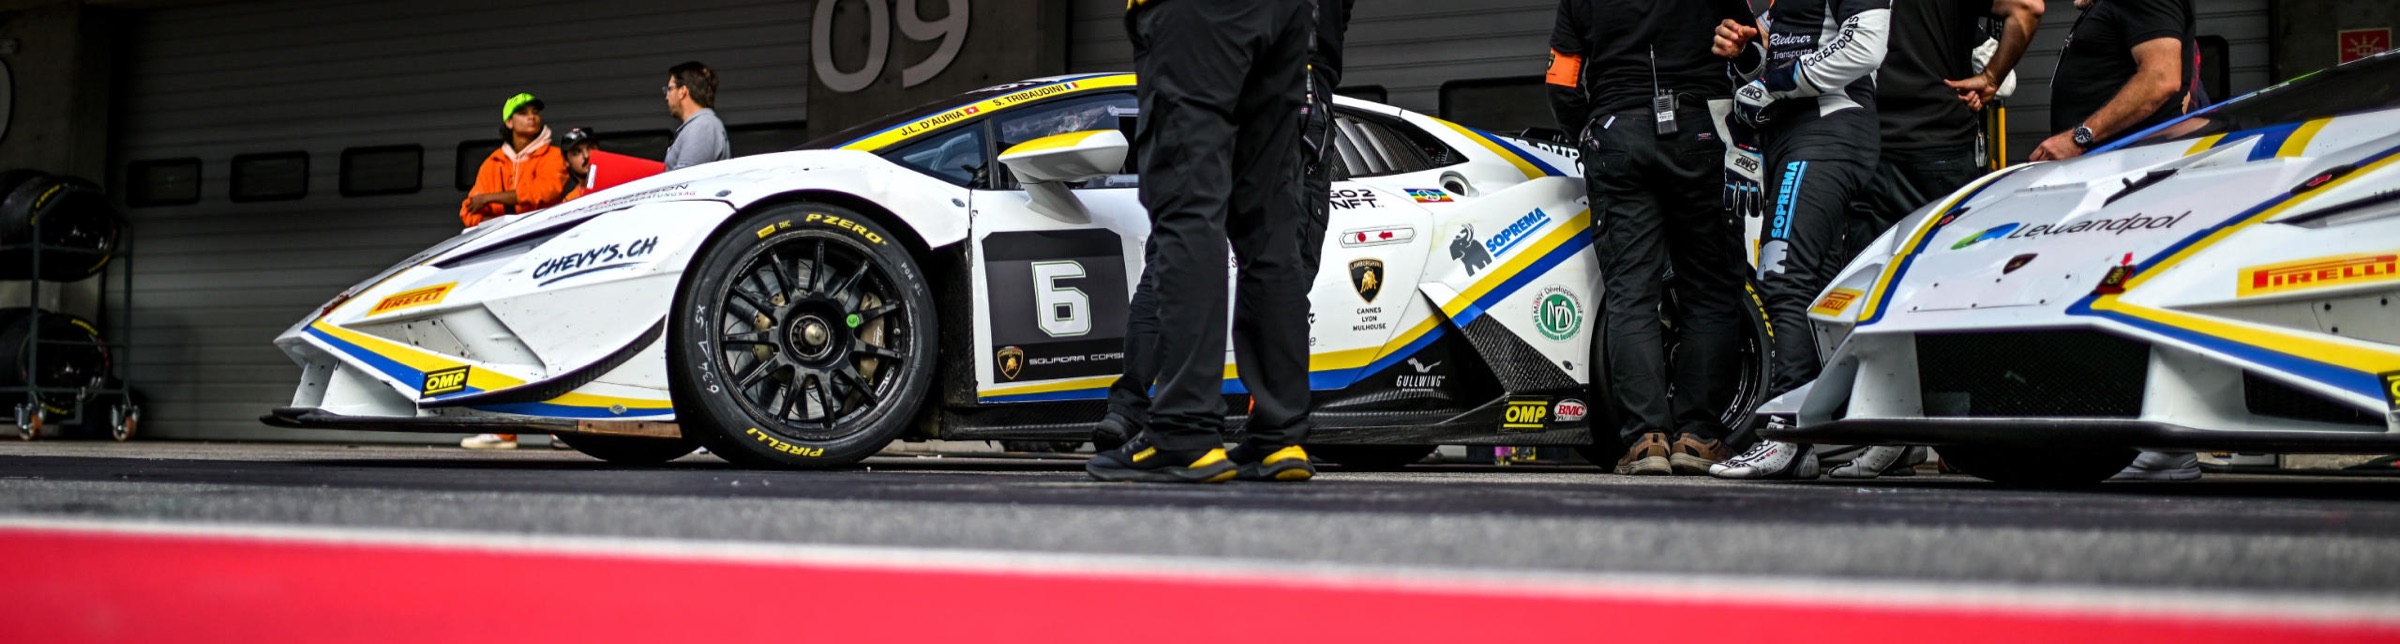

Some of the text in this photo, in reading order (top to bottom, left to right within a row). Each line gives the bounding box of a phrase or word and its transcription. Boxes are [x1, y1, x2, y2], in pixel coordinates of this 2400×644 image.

[811, 0, 969, 92] 09
[1769, 33, 1811, 47] Riederer
[992, 99, 1005, 107] S.
[1004, 85, 1064, 103] TRIBAUDINI
[1741, 86, 1763, 100] OMP
[901, 110, 965, 136] J.L. D'AURIA
[1735, 155, 1759, 173] OMP
[1771, 161, 1801, 239] SOPREMA
[1485, 206, 1547, 253] SOPREMA
[2007, 210, 2192, 240] Lewandpol
[532, 235, 659, 280] CHEVY'S.CH
[2252, 254, 2399, 290] PIRELLI
[375, 286, 448, 312] PIRELLI
[1031, 259, 1092, 338] 6
[1356, 306, 1382, 315] CANNES
[1361, 314, 1378, 323] LYON
[1352, 322, 1387, 332] MULHOUSE
[1029, 354, 1085, 366] SQUADRA
[426, 372, 466, 391] OMP
[1396, 374, 1442, 388] GULLWING
[1505, 405, 1547, 424] OMP
[1557, 404, 1585, 417] BMC
[746, 427, 825, 457] PIRELLI
